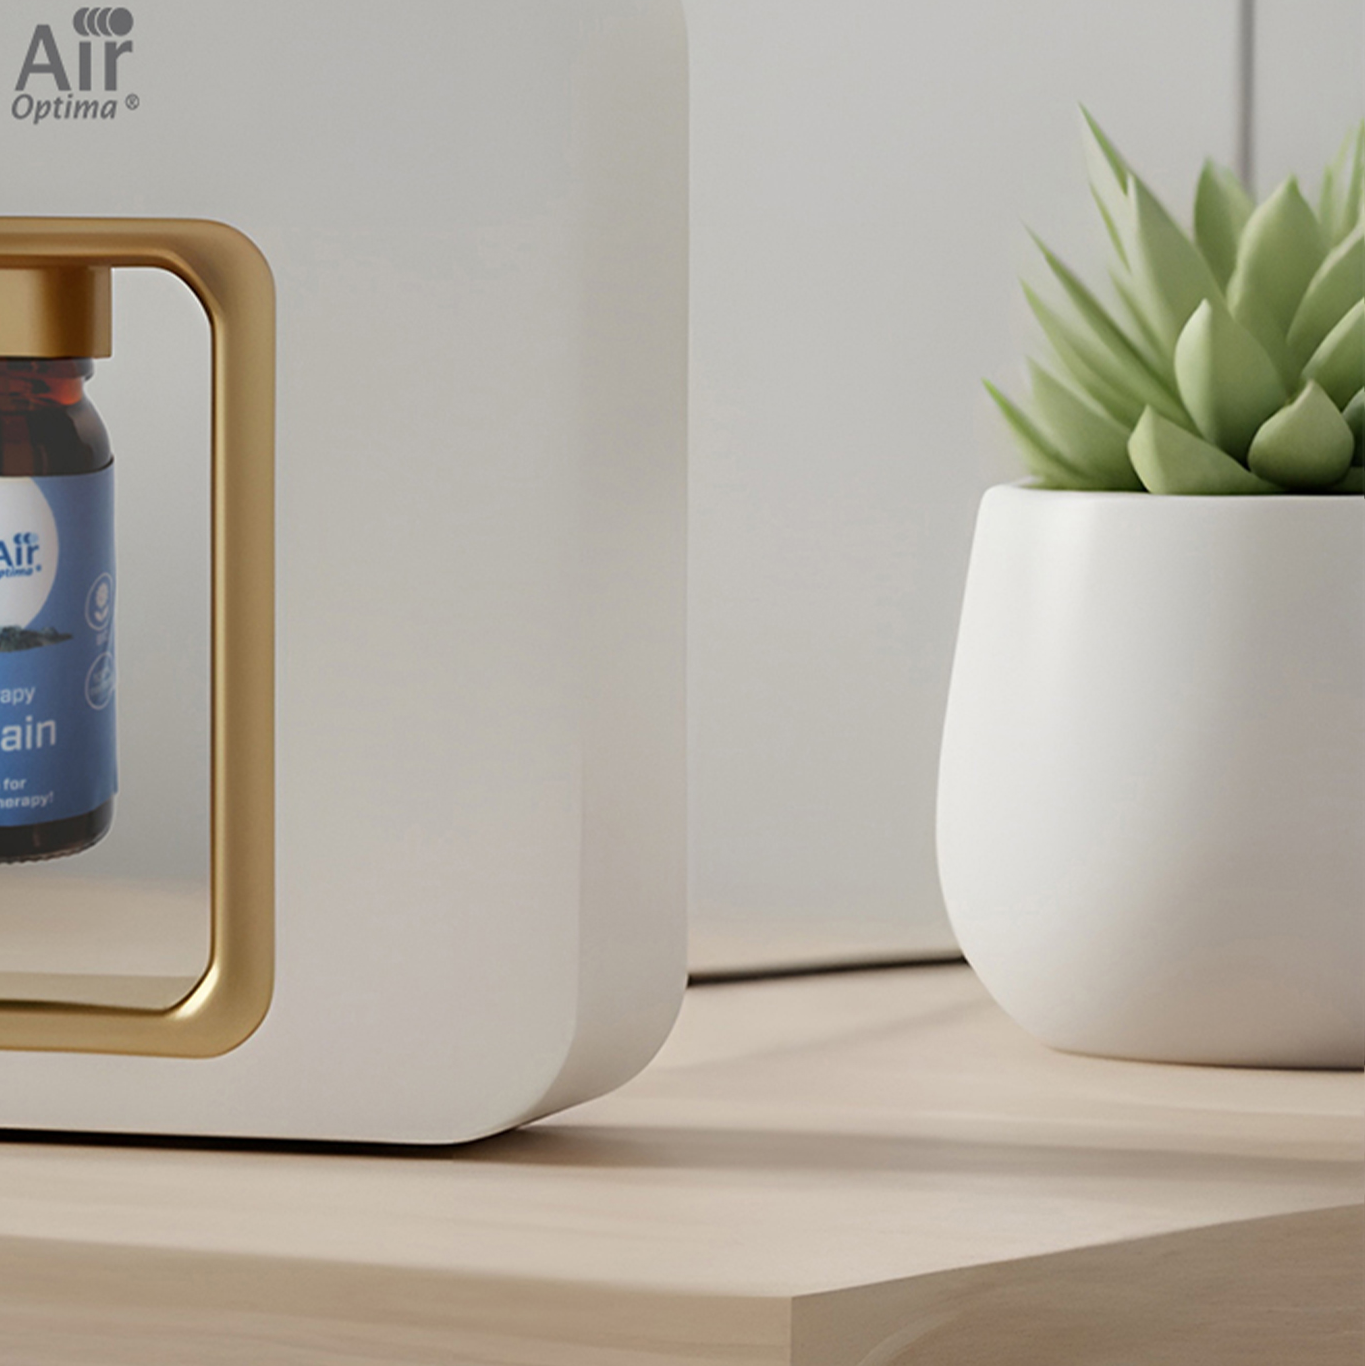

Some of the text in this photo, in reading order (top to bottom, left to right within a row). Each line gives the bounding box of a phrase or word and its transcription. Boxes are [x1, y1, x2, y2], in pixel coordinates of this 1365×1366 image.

[14, 7, 134, 92] Air
[11, 93, 118, 125] Optima
[3, 778, 27, 790] for
